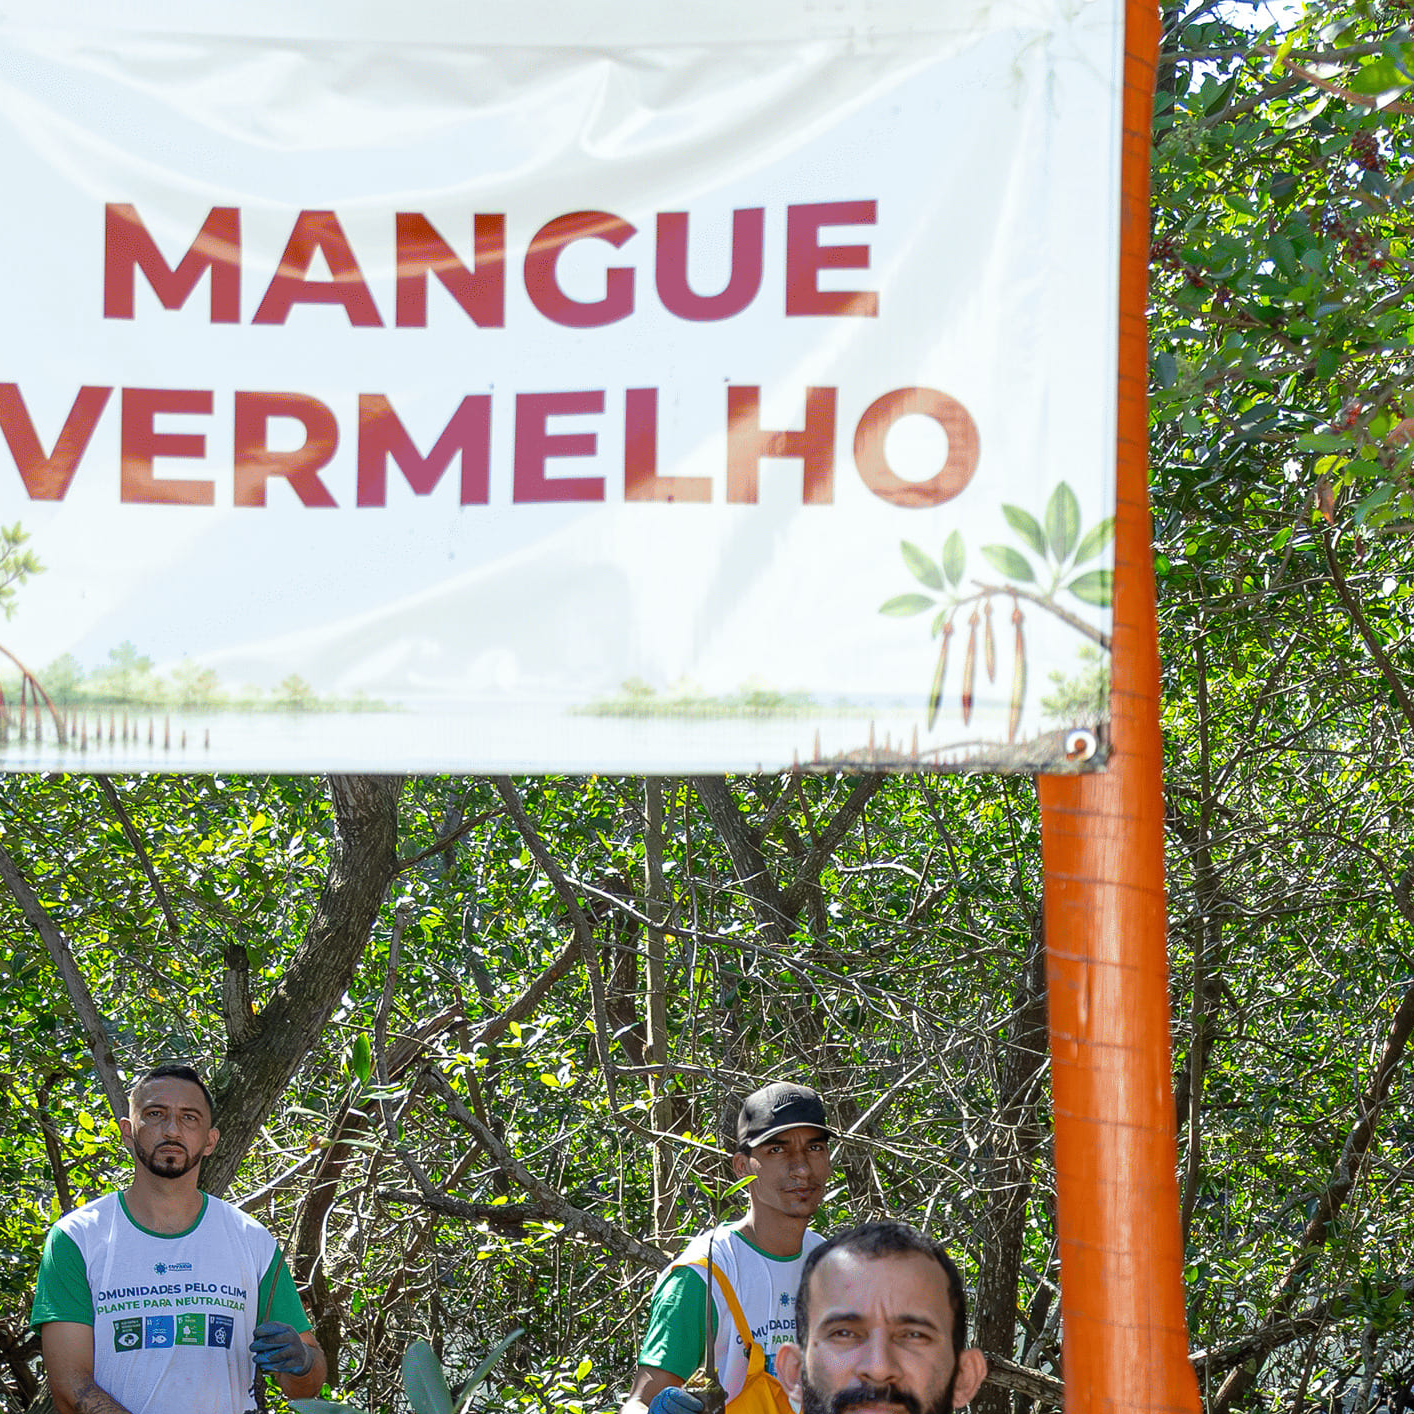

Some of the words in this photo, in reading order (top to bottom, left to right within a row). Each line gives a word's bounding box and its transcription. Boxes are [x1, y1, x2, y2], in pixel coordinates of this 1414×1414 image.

[102, 198, 879, 329] MANGUE
[98, 1284, 181, 1301] OMUNIDADES
[185, 1282, 217, 1294] PELO
[97, 1300, 141, 1315] PLANTE
[144, 1298, 173, 1308] PARA
[175, 1297, 245, 1312] NEUTRALIZAR
